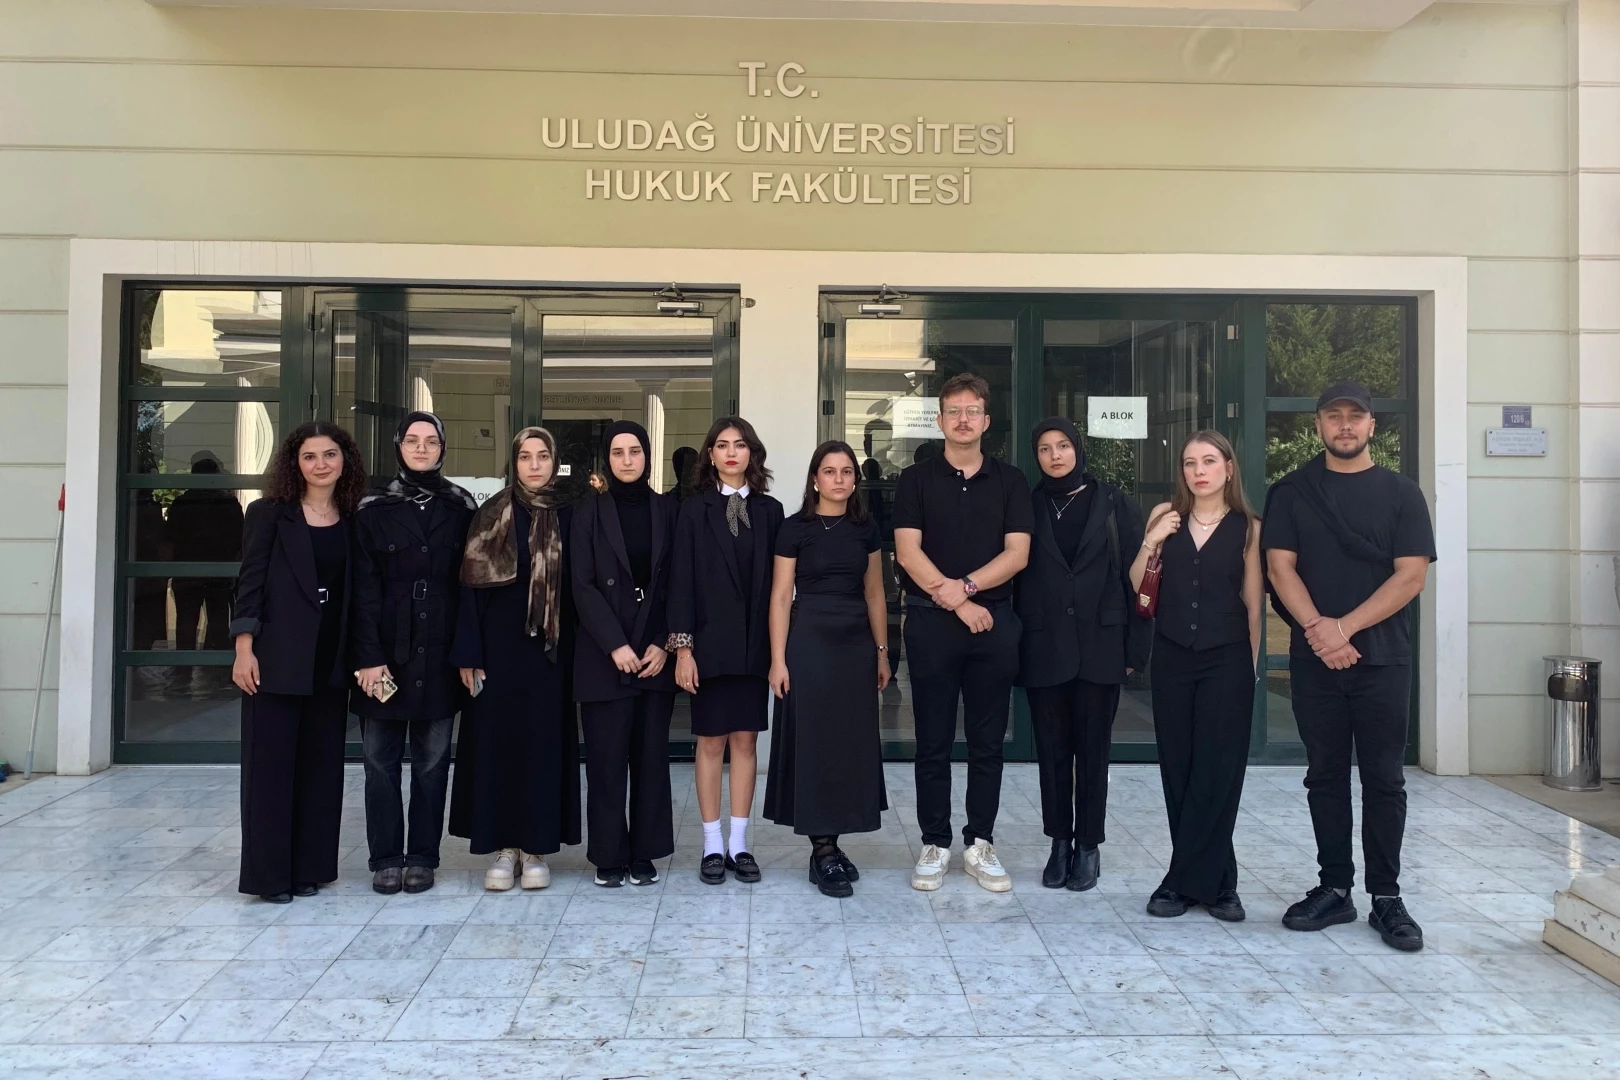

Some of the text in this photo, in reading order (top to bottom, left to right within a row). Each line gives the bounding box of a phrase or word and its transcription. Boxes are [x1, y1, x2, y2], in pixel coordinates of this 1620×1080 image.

[738, 61, 819, 98] T.C.
[541, 112, 1014, 155] ULUDAĞ ÜNİVERSİTESİ
[585, 166, 971, 204] HUKUK FAKÜLTESİ
[473, 492, 491, 501] LOK
